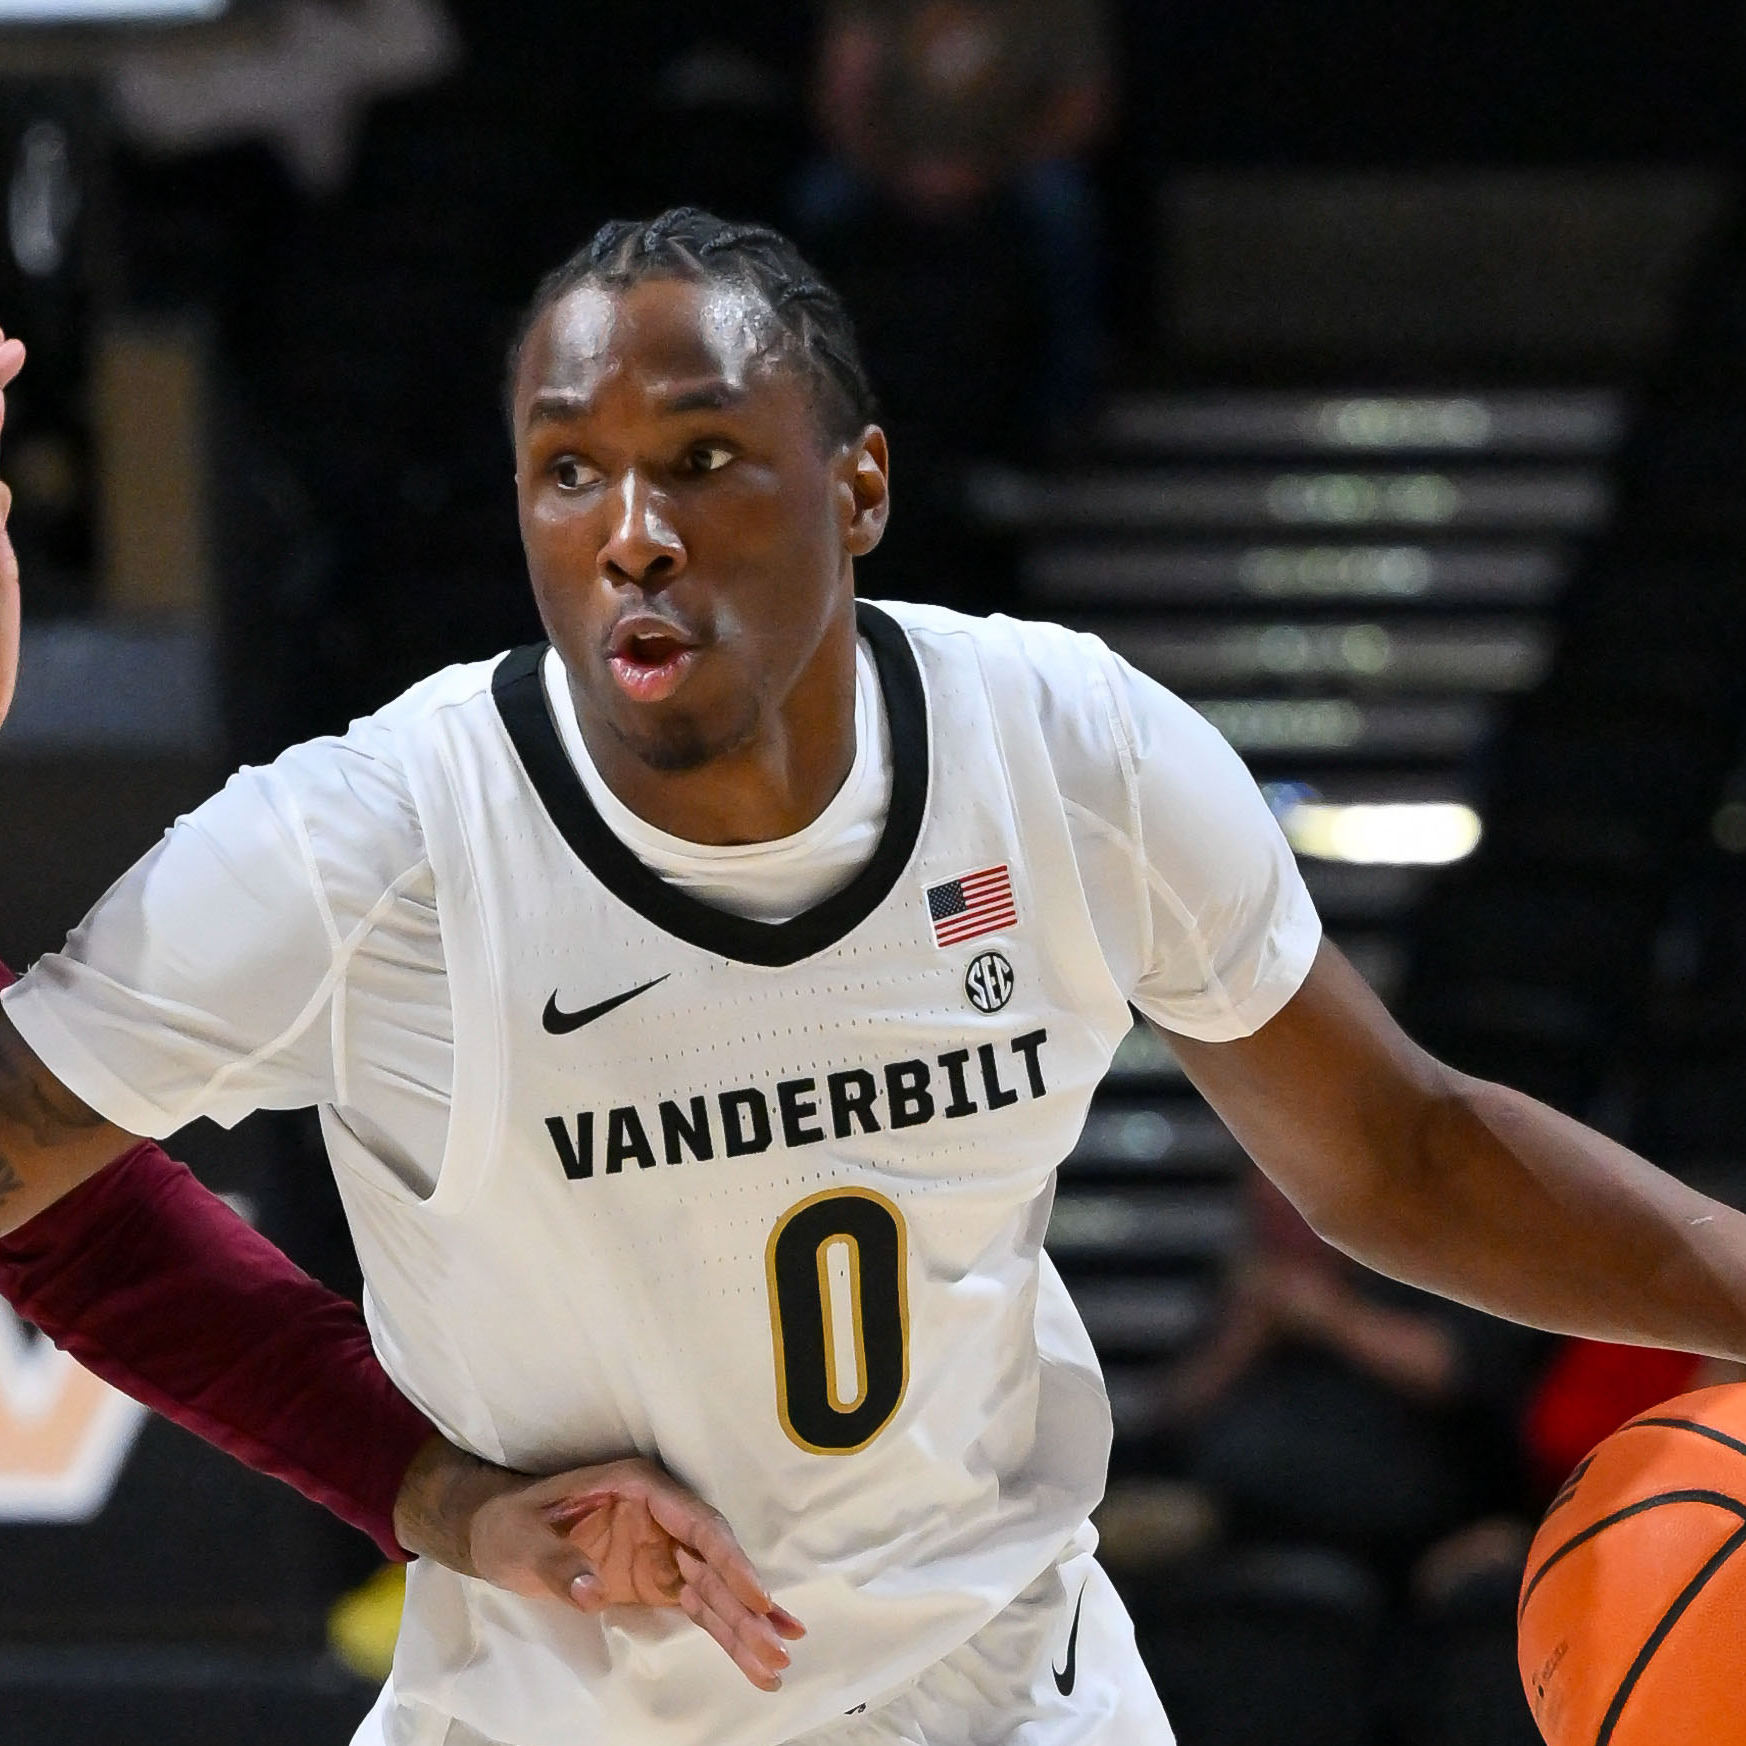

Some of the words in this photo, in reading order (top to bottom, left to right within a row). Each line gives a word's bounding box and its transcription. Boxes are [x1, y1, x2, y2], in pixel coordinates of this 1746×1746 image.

[967, 955, 1012, 1010] SEC
[544, 1028, 1049, 1181] VANDERBILT
[764, 1186, 910, 1457] 0
